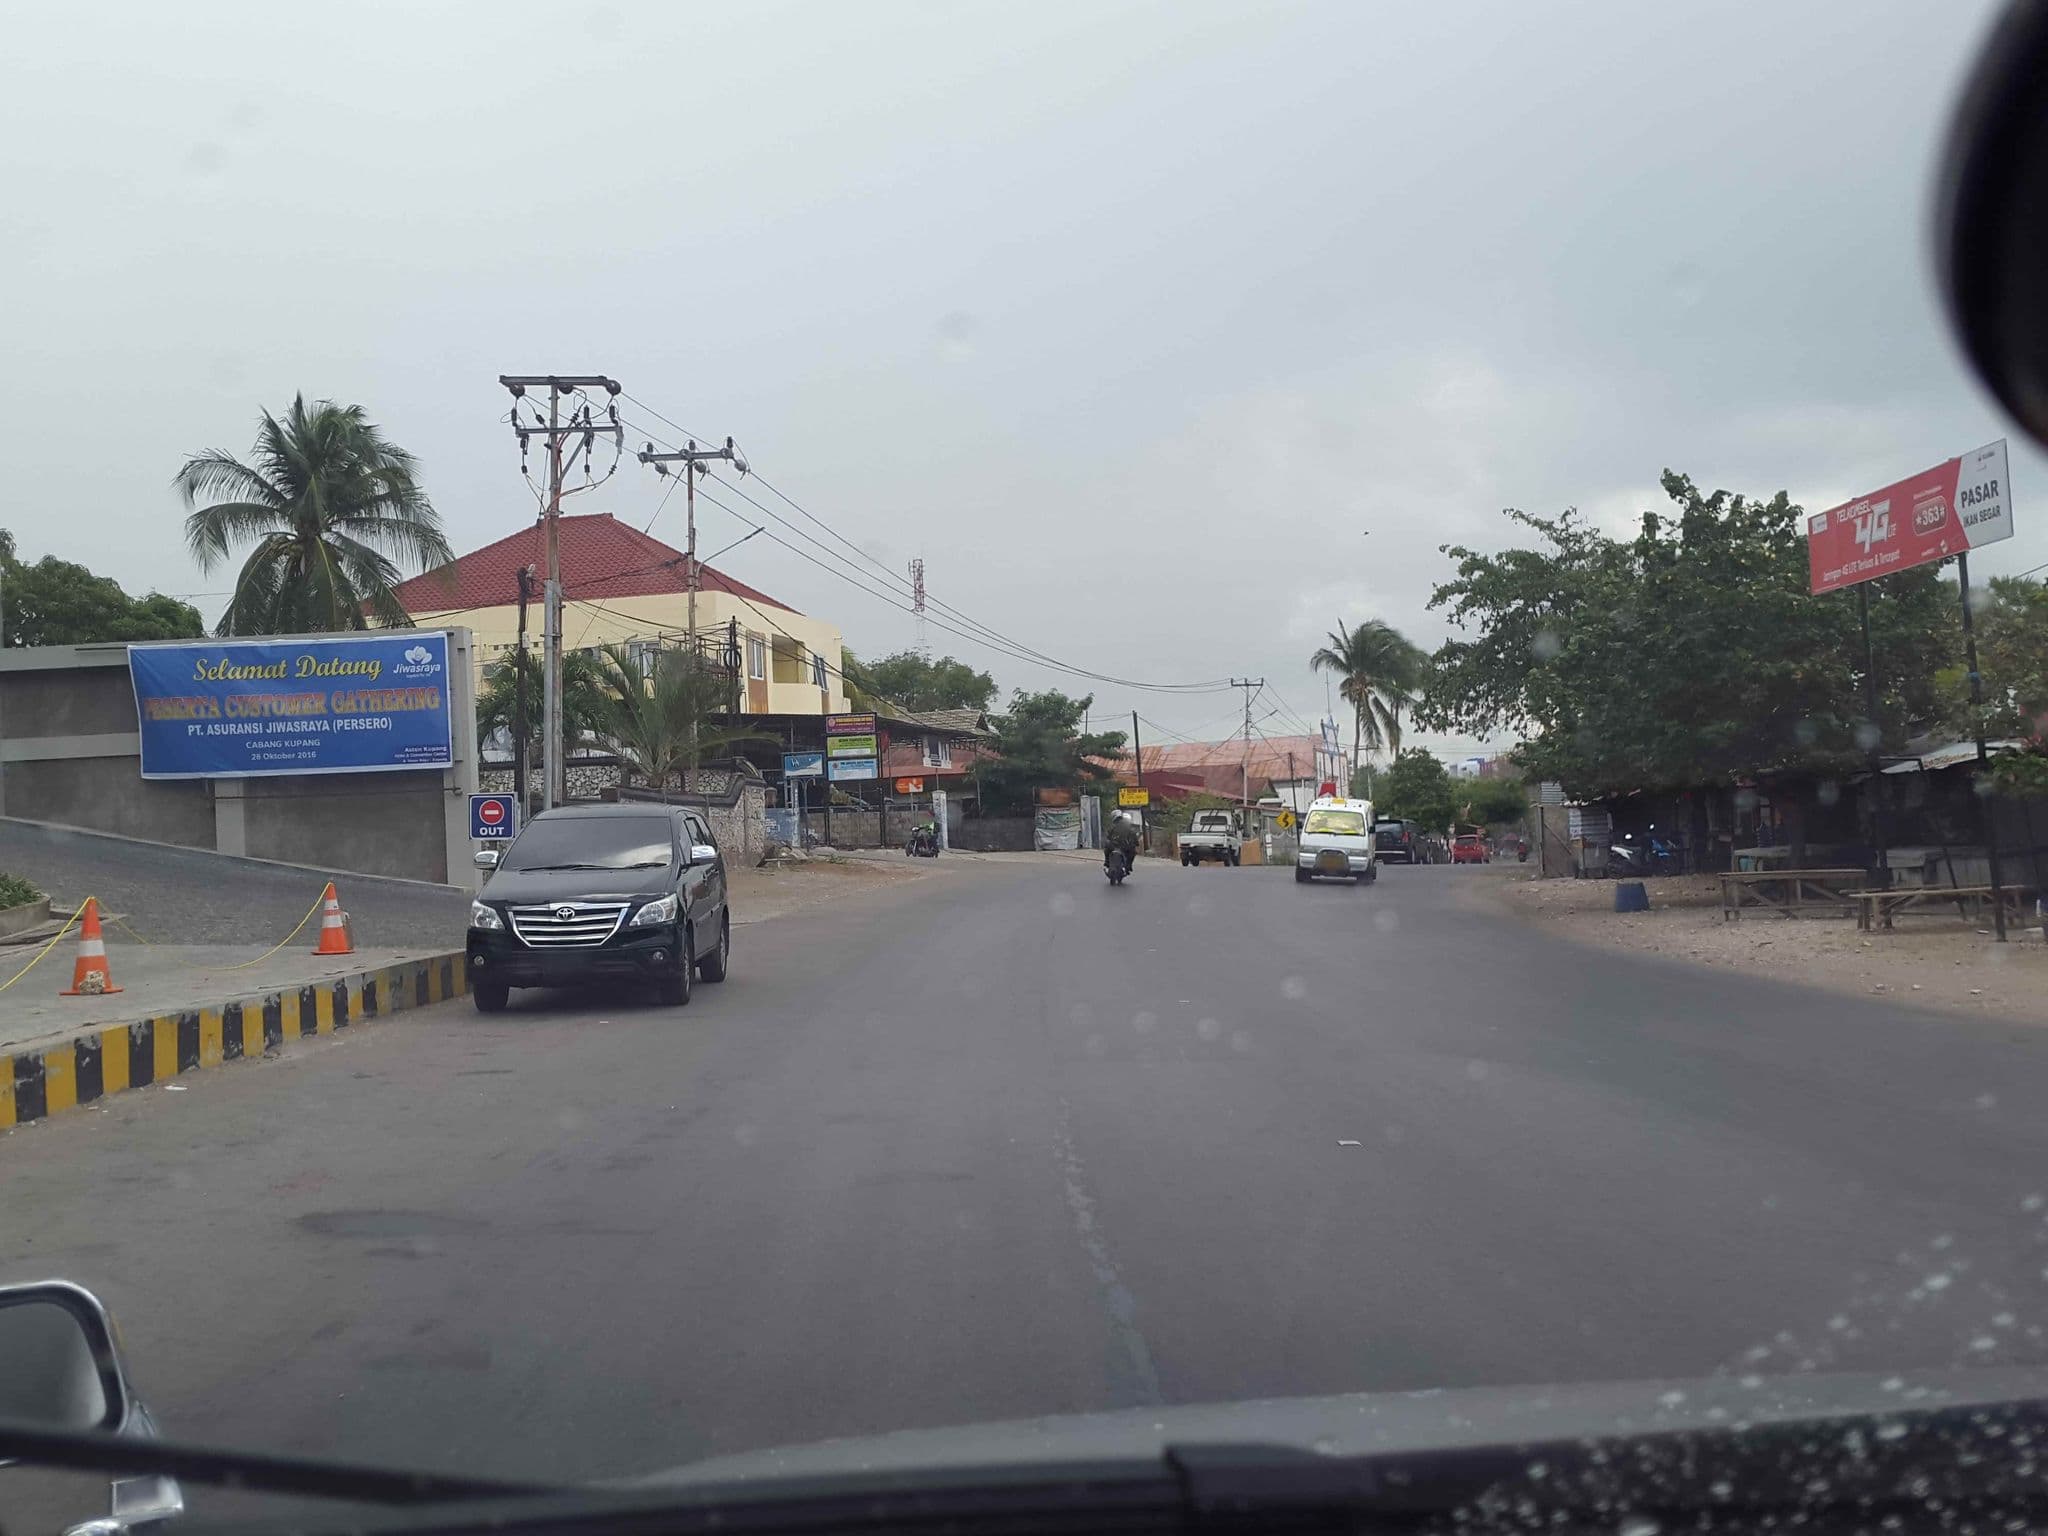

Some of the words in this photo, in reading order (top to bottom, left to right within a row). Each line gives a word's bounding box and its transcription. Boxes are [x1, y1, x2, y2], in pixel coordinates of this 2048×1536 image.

[1961, 480, 1999, 508] PASAR
[1980, 505, 2001, 523] SEGAR
[193, 657, 287, 681] Selamat
[295, 655, 383, 681] Datang
[393, 663, 441, 674] Jiwasraya
[225, 692, 328, 719] CUSTOMER
[331, 687, 441, 714] GATHERING
[188, 724, 204, 736] PT.
[207, 722, 264, 736] ASURANSI
[266, 720, 330, 734] JIWASRAYA
[333, 717, 392, 733] (PERSERO)
[245, 740, 283, 749] CABANG
[284, 739, 321, 748] KUPANG
[263, 752, 296, 760] Oktober
[297, 751, 317, 759] 2016
[479, 826, 505, 836] OUT
